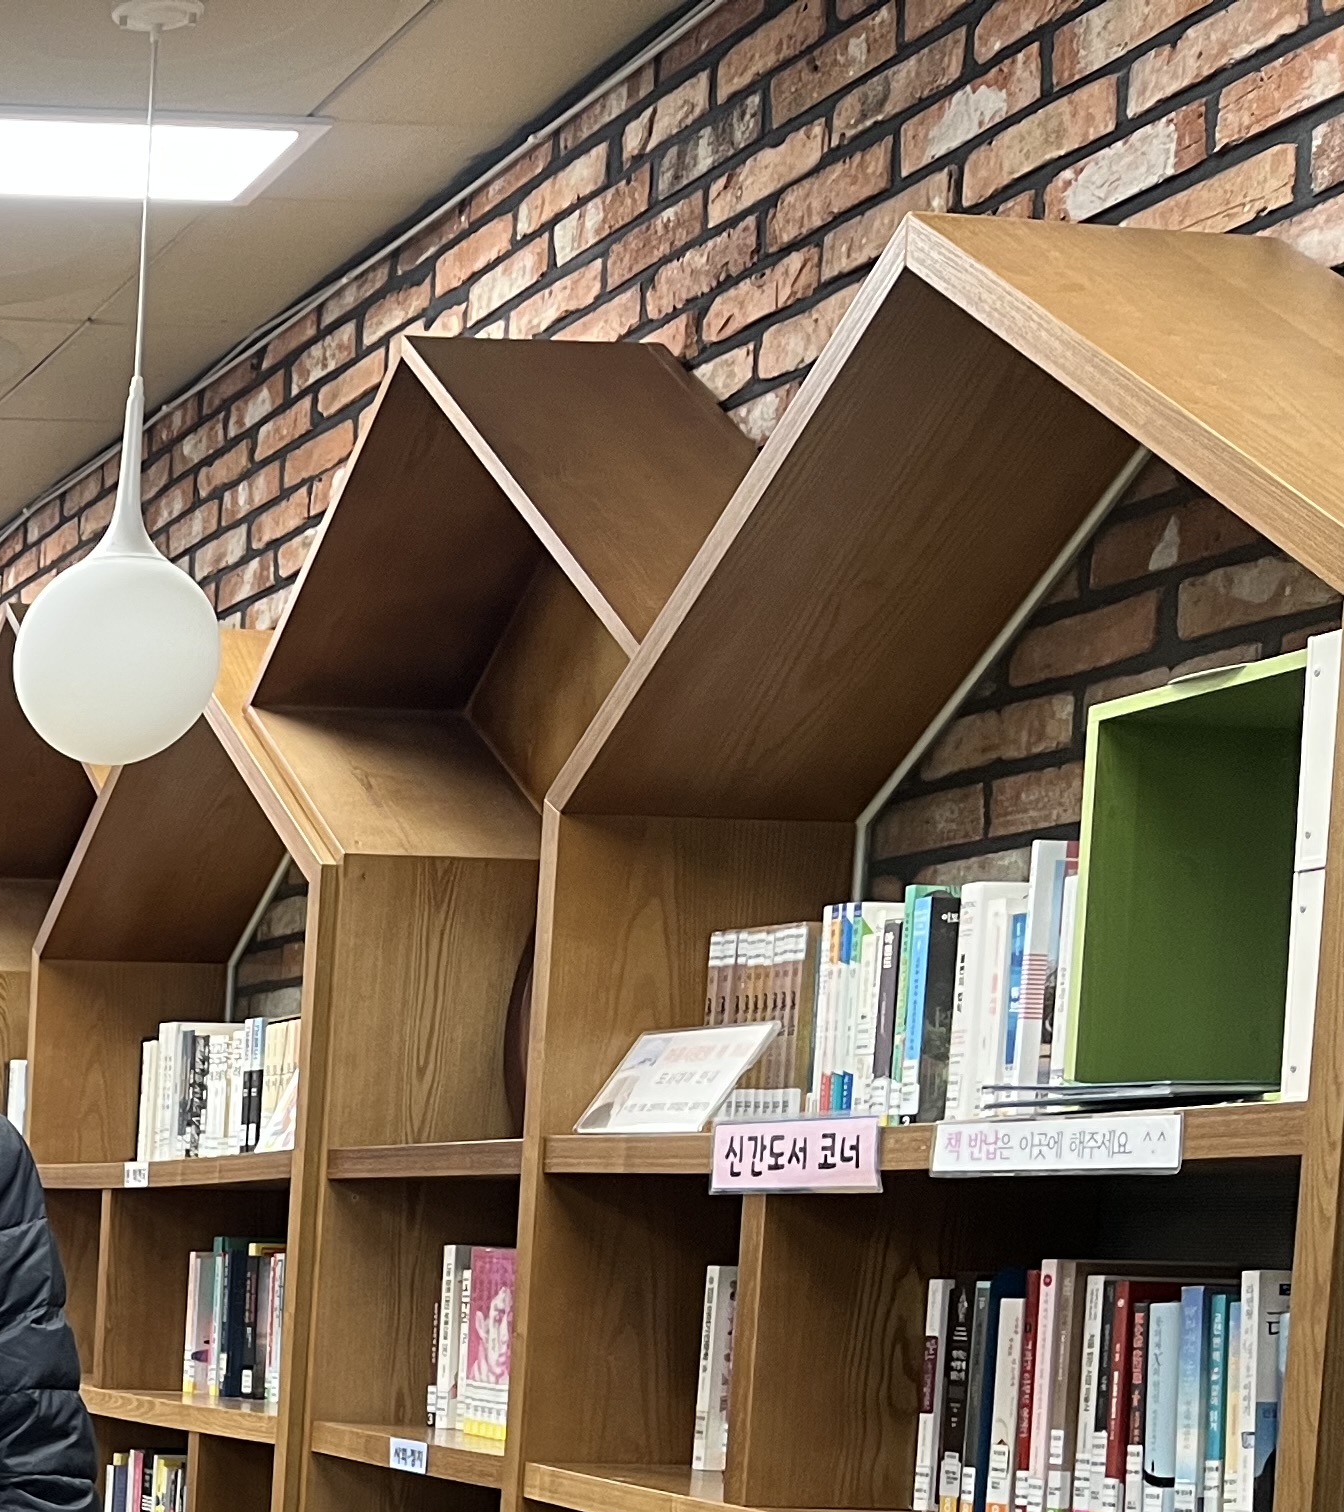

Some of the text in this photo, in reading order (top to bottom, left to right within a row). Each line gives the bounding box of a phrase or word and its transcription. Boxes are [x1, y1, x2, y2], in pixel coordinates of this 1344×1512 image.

[724, 1132, 861, 1178] 신간도서 코너
[944, 1131, 963, 1162] 책
[967, 1130, 1014, 1162] 반납은
[1019, 1130, 1064, 1161] 이곳에
[1069, 1130, 1132, 1158] 해주세요
